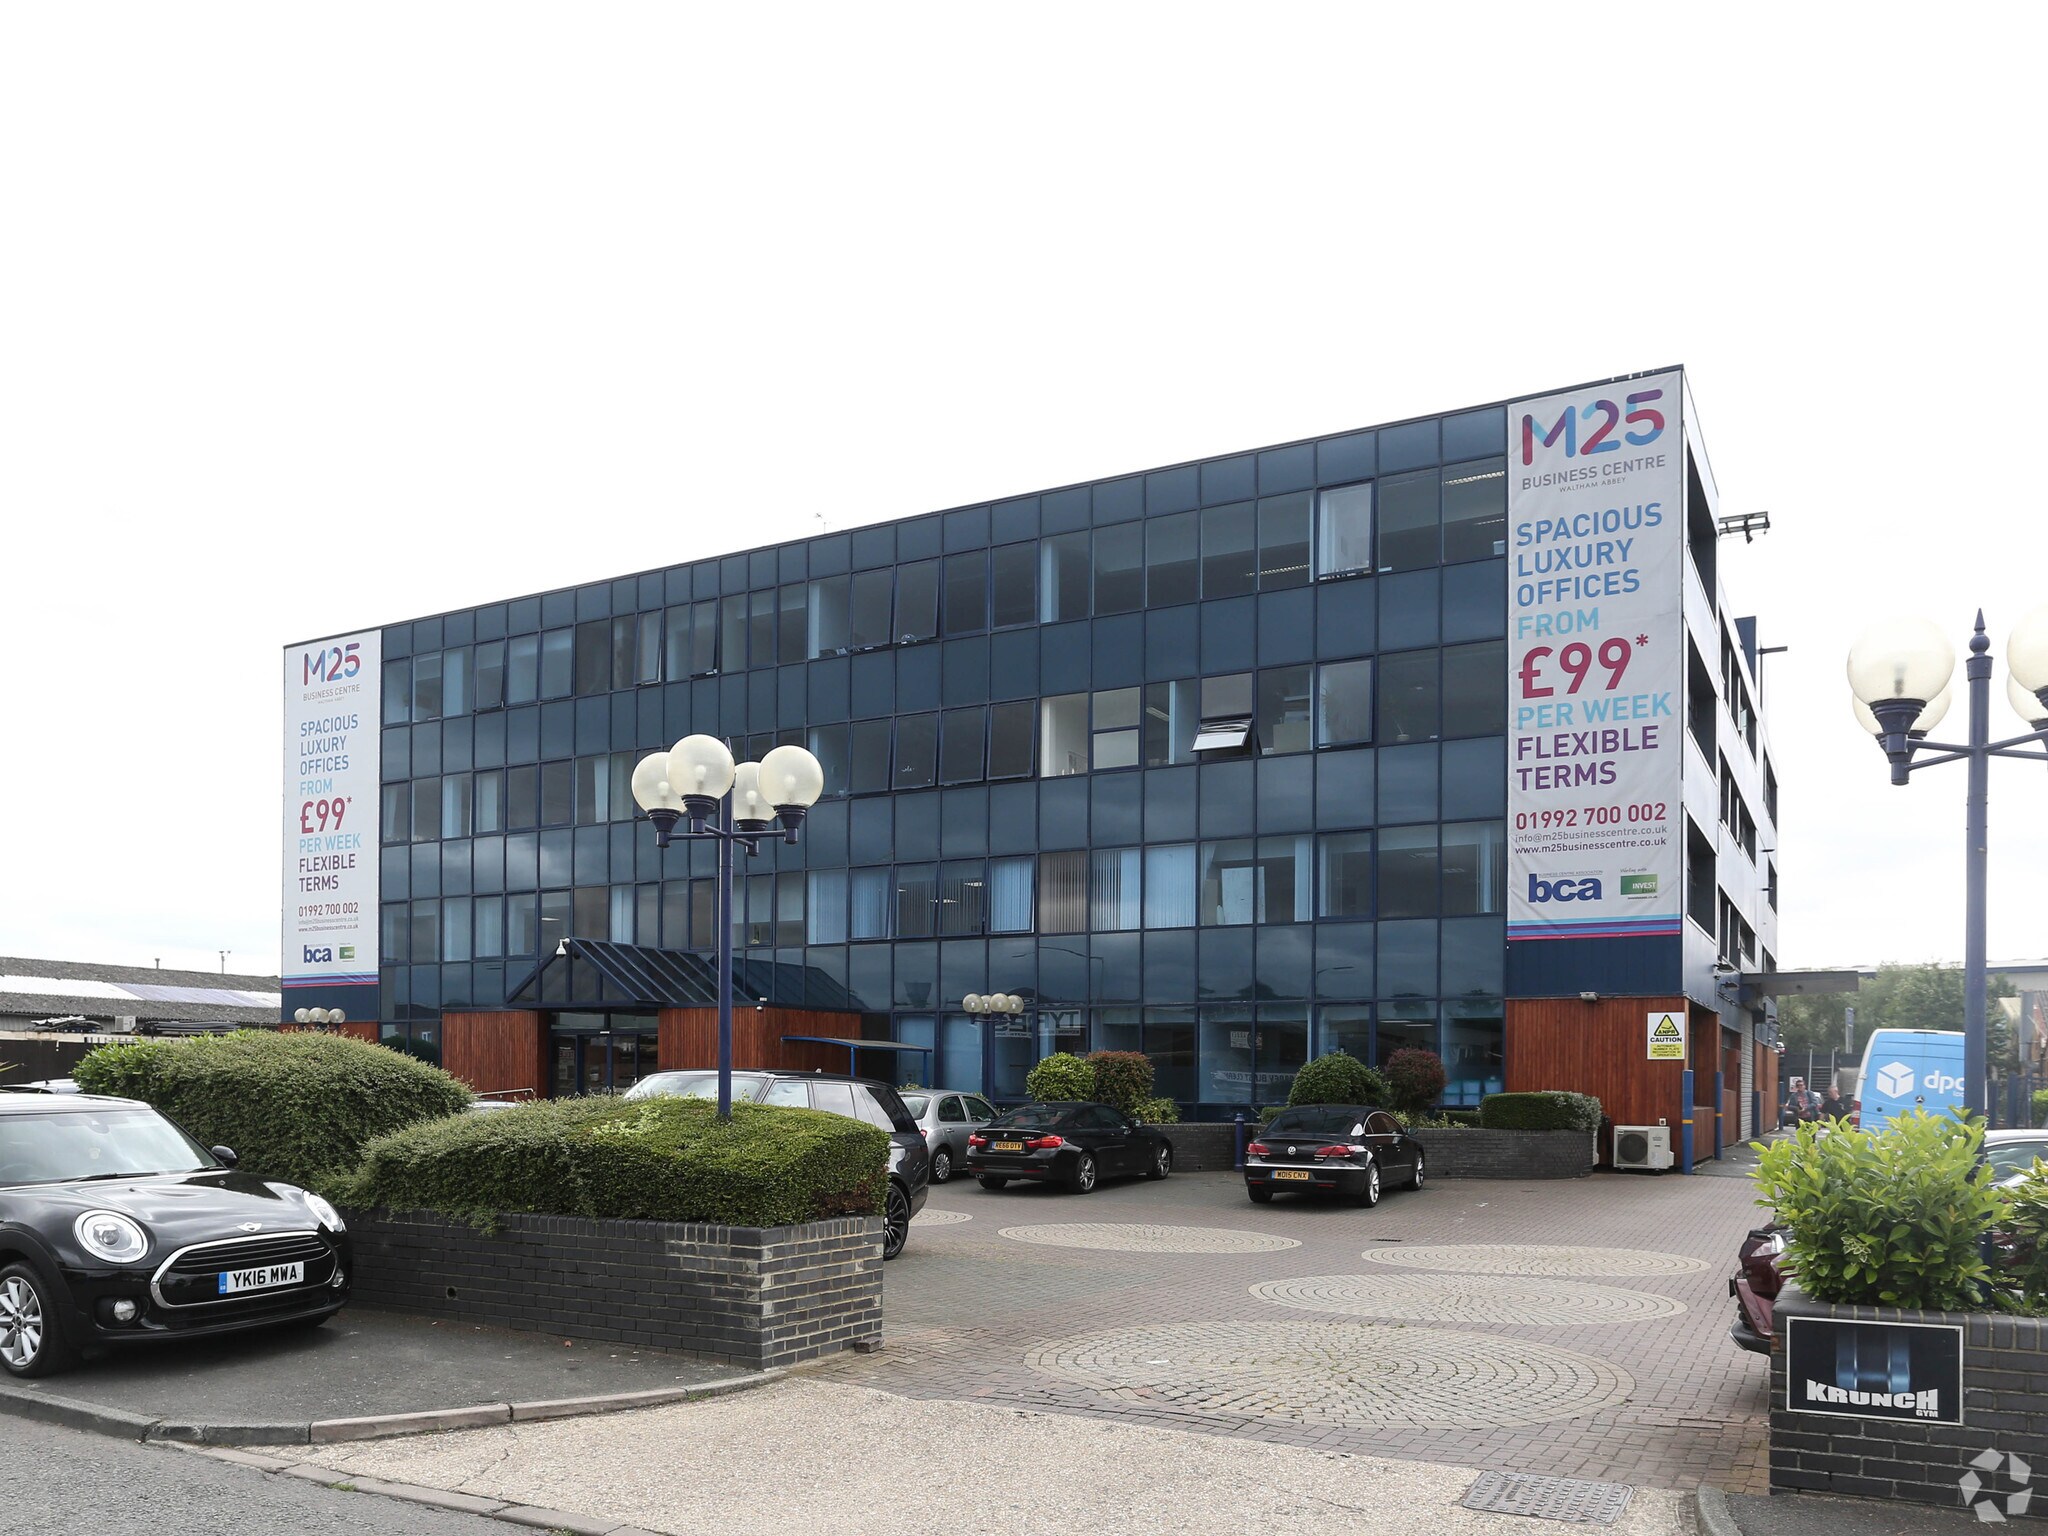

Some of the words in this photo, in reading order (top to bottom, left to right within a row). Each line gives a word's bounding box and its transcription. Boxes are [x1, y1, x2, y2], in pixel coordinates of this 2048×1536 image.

[1522, 388, 1665, 466] M25
[1522, 465, 1597, 490] BUSINESS
[1602, 454, 1666, 477] CENTRE
[1559, 481, 1598, 493] WALTHAM
[1601, 476, 1627, 487] ABBEY
[1516, 502, 1663, 547] SPACIOUS
[1517, 537, 1634, 577] LUXURY
[1517, 568, 1640, 607] OFFICES
[1517, 606, 1599, 640] FROM
[303, 642, 361, 686] M25
[303, 689, 334, 702] BUSINESS
[334, 684, 361, 696] CENTRE
[1517, 702, 1574, 730] PER
[1582, 691, 1672, 723] WEEK
[300, 713, 359, 737] SPACIOUS
[300, 735, 347, 757] LUXURY
[1517, 725, 1659, 761] FLEXIBLE
[300, 755, 349, 776] OFFICES
[1516, 760, 1617, 791] TERMS
[300, 778, 333, 796] FROM
[1515, 809, 1577, 830] 01992
[1583, 806, 1621, 826] 700
[1627, 803, 1666, 822] 002
[299, 837, 322, 854] PER
[324, 832, 361, 851] WEEK
[1515, 825, 1668, 843] info@m25businesscentre.co.uk
[1515, 837, 1667, 854] www.m25businesscentre.co.uk
[299, 853, 356, 873] FLEXIBLE
[299, 874, 339, 893] TERMS
[1528, 873, 1602, 903] bca
[1632, 881, 1657, 889] INVEST
[298, 904, 323, 917] 01992
[325, 903, 341, 915] 700
[343, 901, 359, 914] 002
[303, 944, 332, 963] bca
[232, 1269, 266, 1288] YK16
[270, 1264, 297, 1283] MWA
[1806, 1378, 1938, 1410] KRUNCH
[1915, 1409, 1939, 1418] GYM
